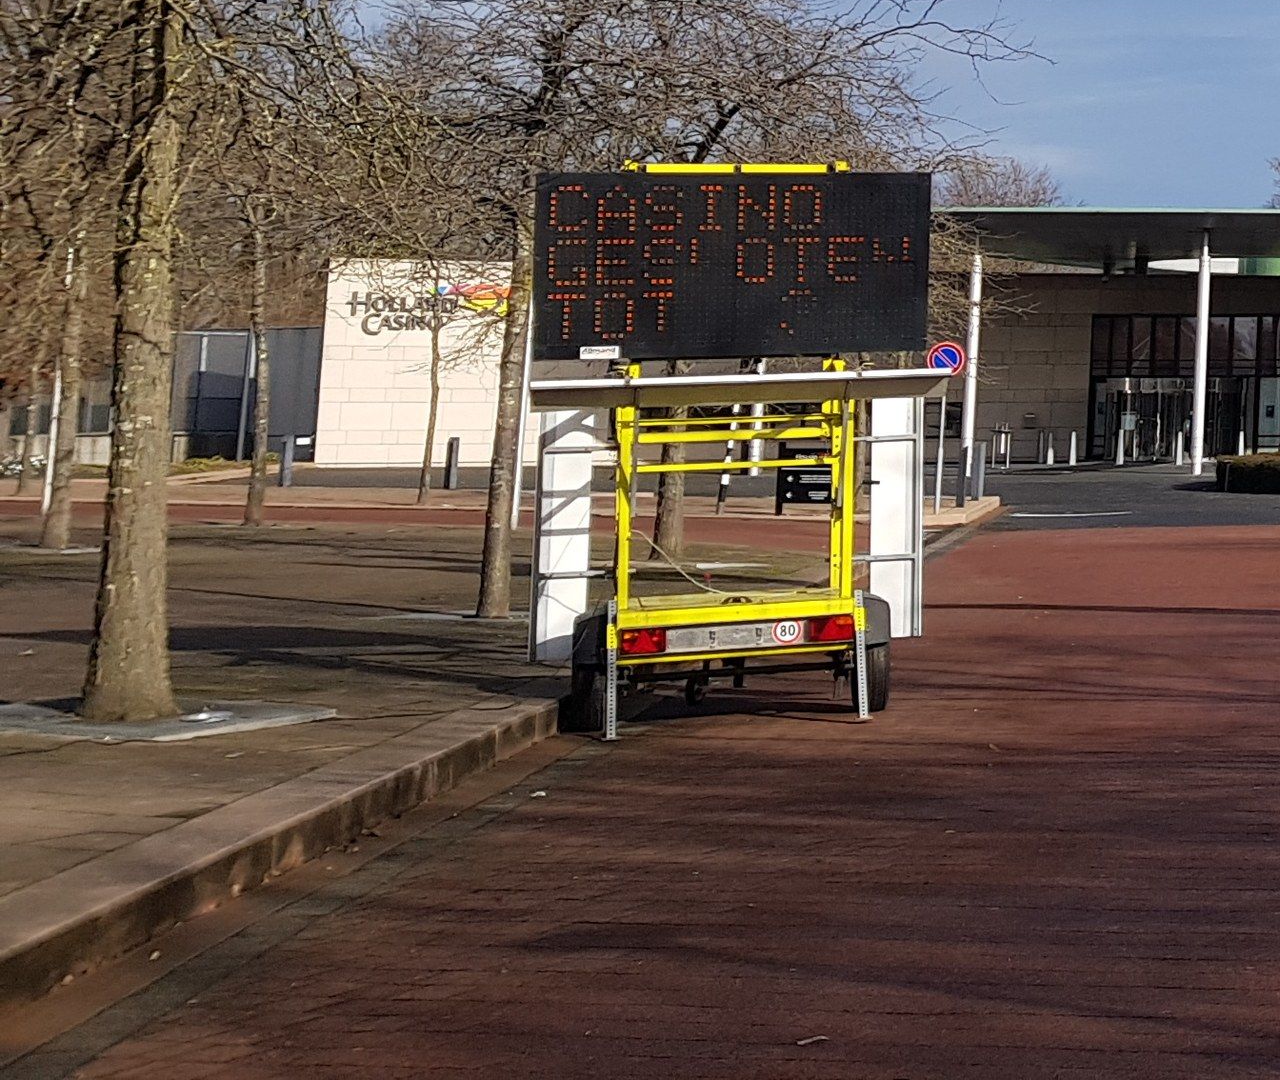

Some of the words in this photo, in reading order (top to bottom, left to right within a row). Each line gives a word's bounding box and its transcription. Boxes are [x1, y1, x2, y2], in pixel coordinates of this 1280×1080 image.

[548, 184, 823, 232] CASINO
[346, 291, 458, 317] HOLLAND
[546, 290, 675, 341] TOT
[779, 624, 796, 637] 80
